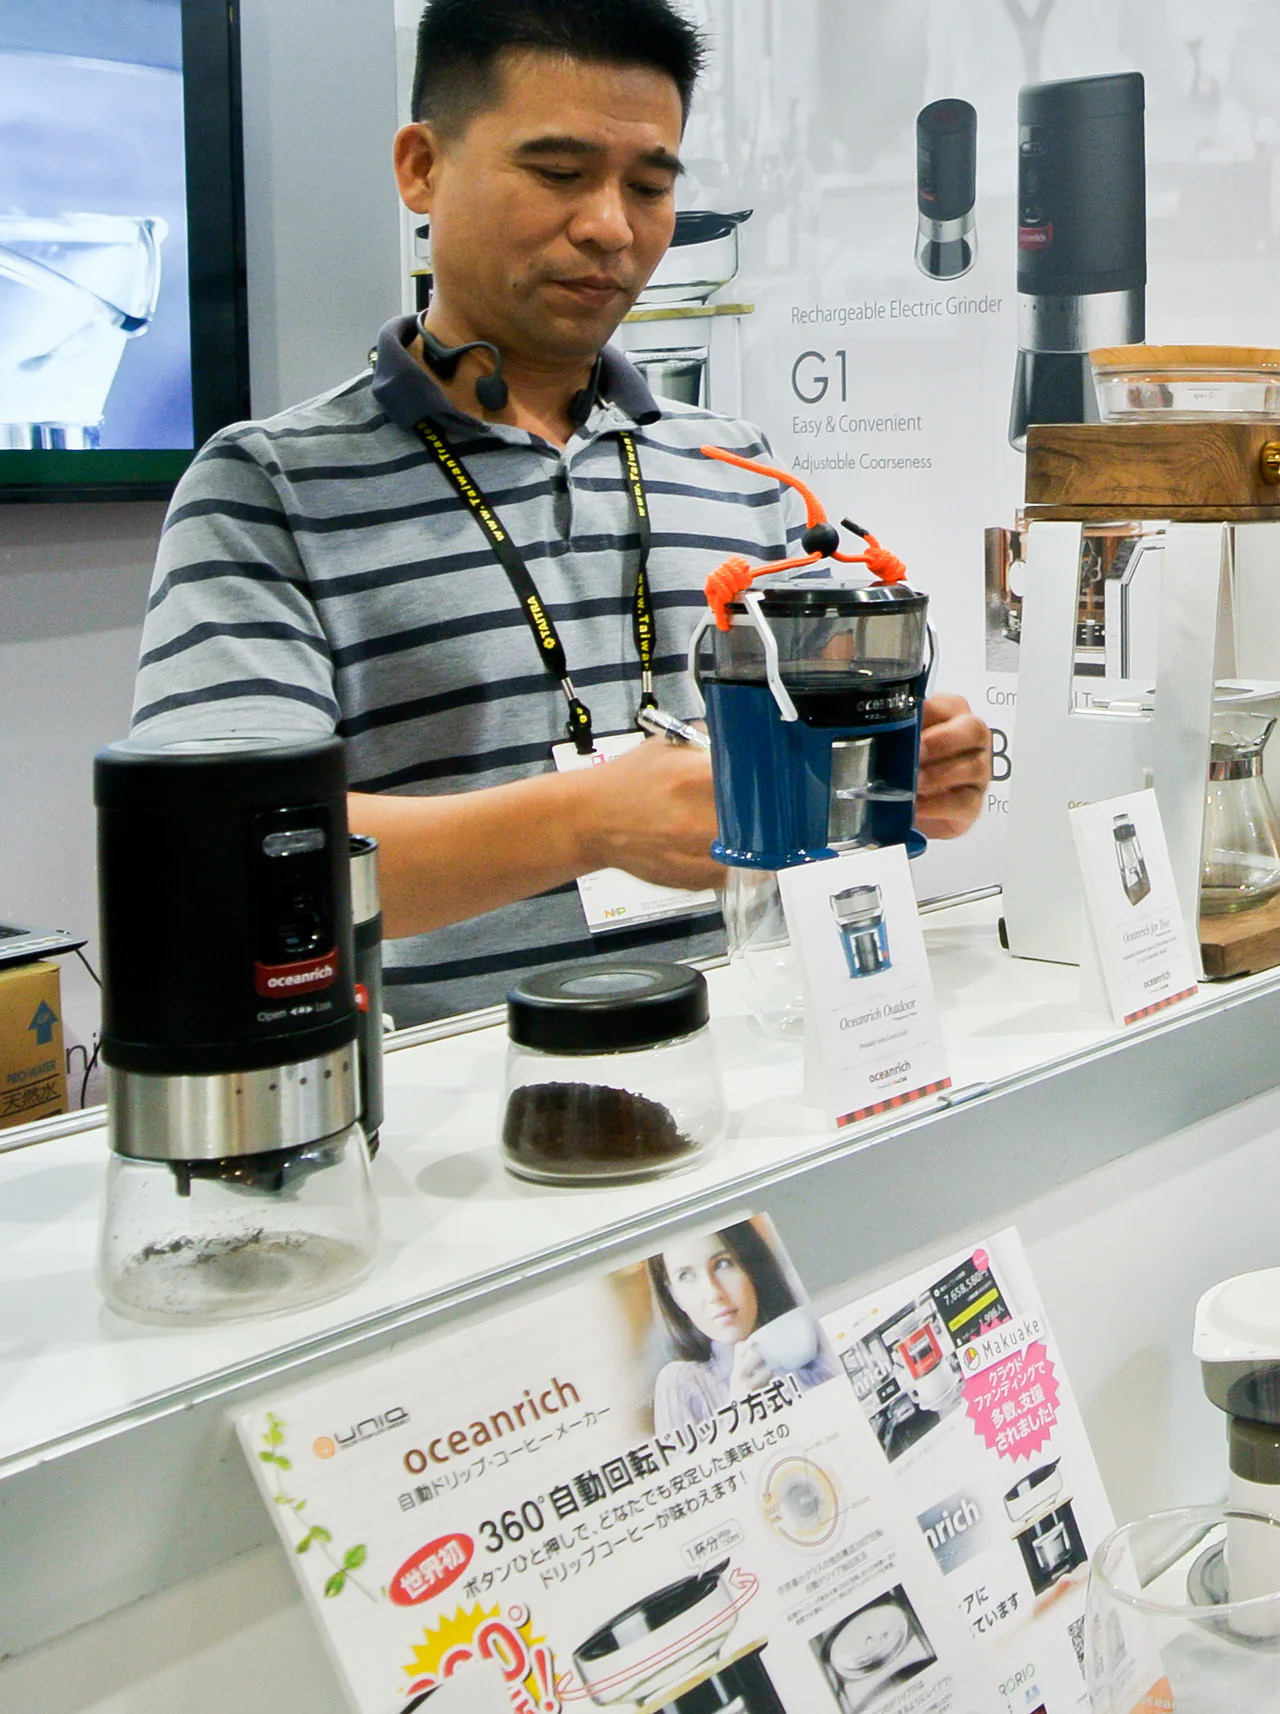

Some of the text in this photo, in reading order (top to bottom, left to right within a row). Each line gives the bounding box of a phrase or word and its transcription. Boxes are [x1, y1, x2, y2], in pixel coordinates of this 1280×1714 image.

[791, 294, 1003, 326] Rechargeable Electric Grinder
[791, 350, 847, 404] G1
[792, 413, 922, 438] Easy & Convenient
[792, 452, 932, 474] Adjustable Coarseness
[527, 595, 551, 639] TAITRA
[266, 963, 334, 989] oceanrich
[256, 1009, 288, 1023] Open
[839, 1006, 883, 1031] Oceanrich
[883, 999, 917, 1017] Outdoor
[868, 1060, 912, 1084] oceanrich
[981, 1320, 1040, 1359] Makuake
[973, 1361, 1047, 1412] ファンディングで
[988, 1356, 1023, 1387] クラウド
[403, 1377, 581, 1475] oceanrich
[400, 1538, 467, 1600] 世界初
